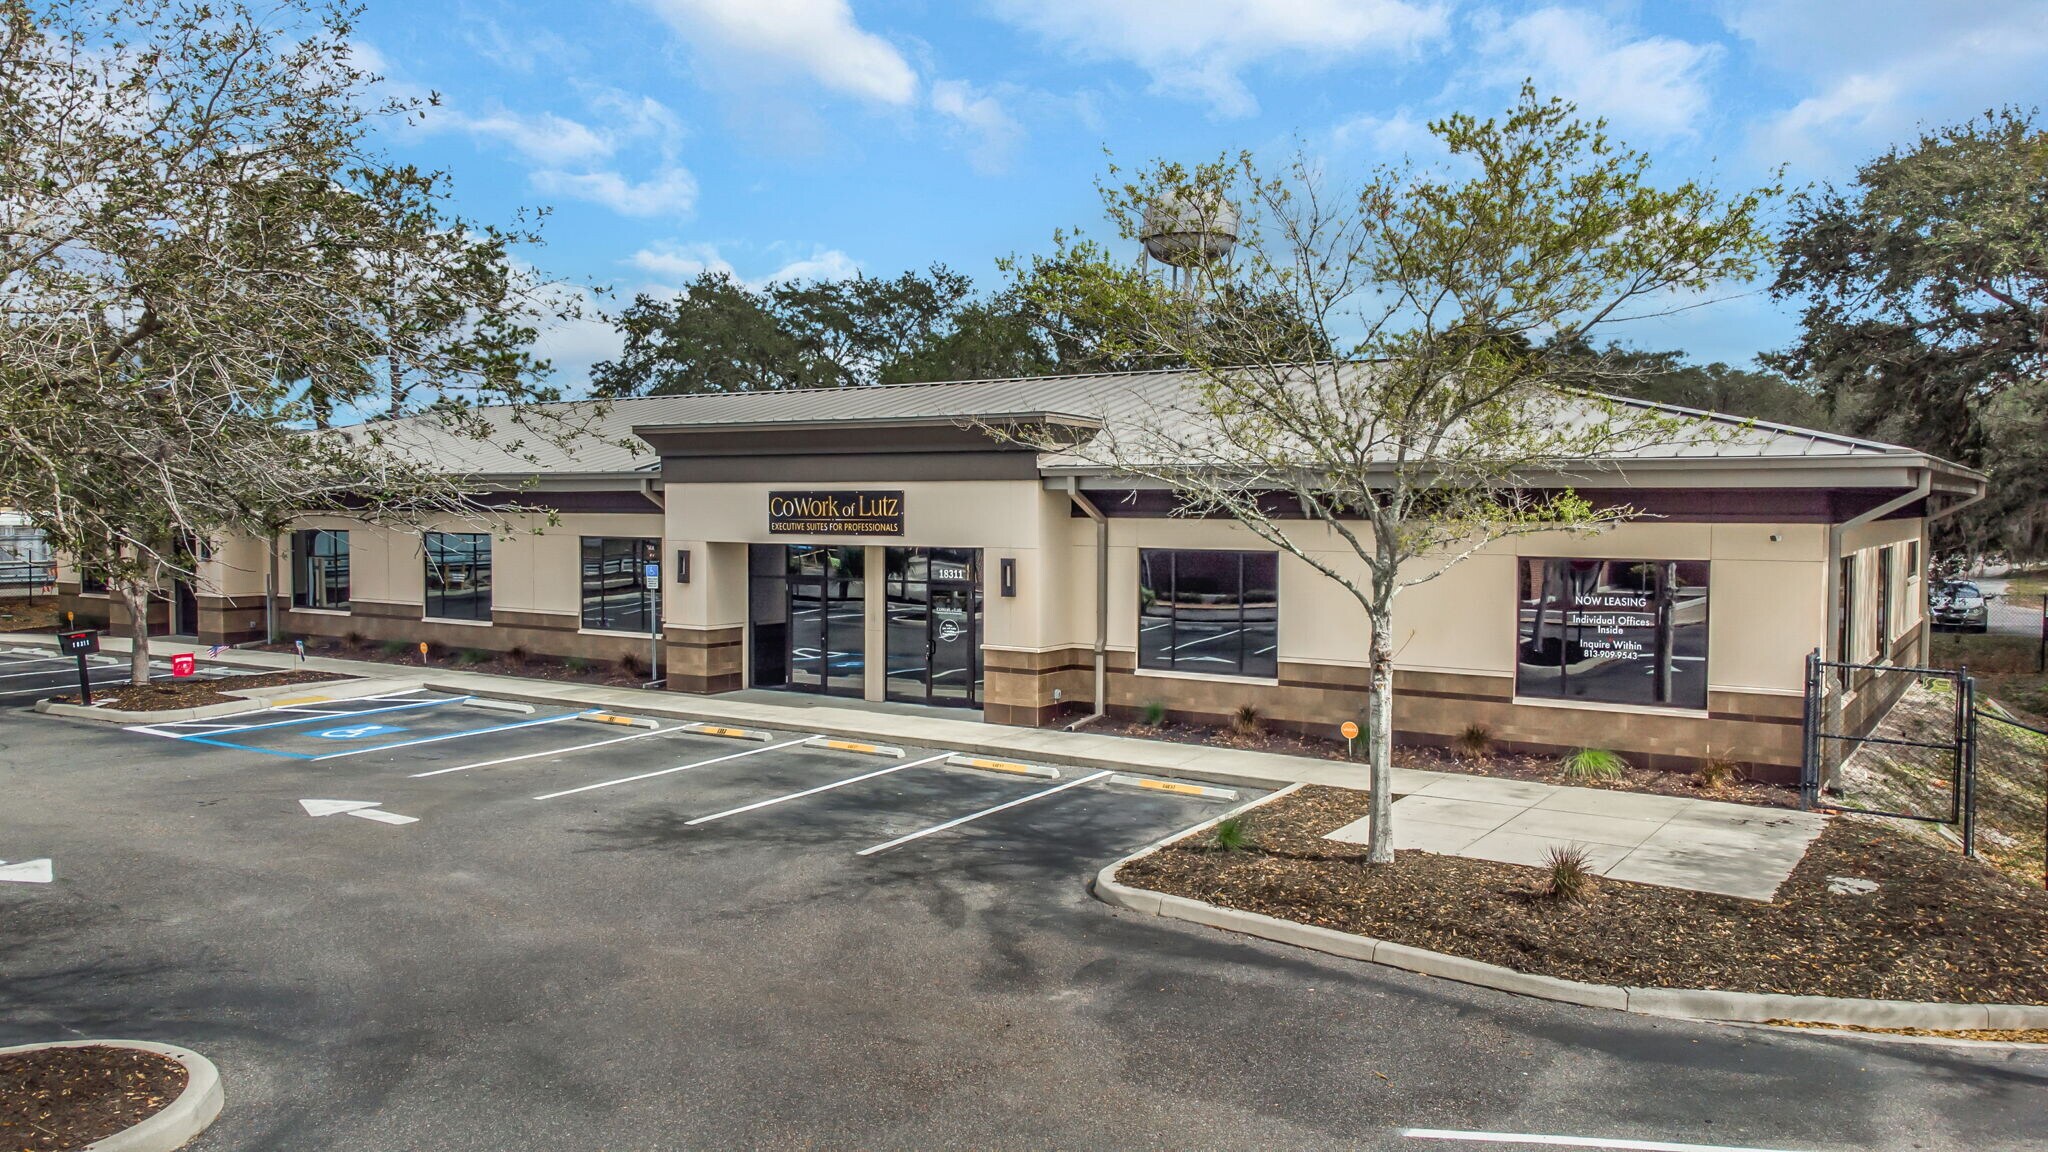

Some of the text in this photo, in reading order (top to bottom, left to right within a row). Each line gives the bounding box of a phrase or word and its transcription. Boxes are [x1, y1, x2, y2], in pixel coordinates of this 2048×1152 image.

[771, 495, 898, 517] CoWork of Lutz
[771, 522, 898, 532] EXECUTIVE SUITES FOR PROFESSIONALS
[939, 569, 963, 579] 18311
[1575, 596, 1647, 607] NOW LEASING
[1572, 614, 1650, 626] Individual Offices
[1597, 625, 1624, 634] Inside
[1579, 639, 1642, 650] Inquire Within
[1583, 650, 1638, 660] 813-909-9543
